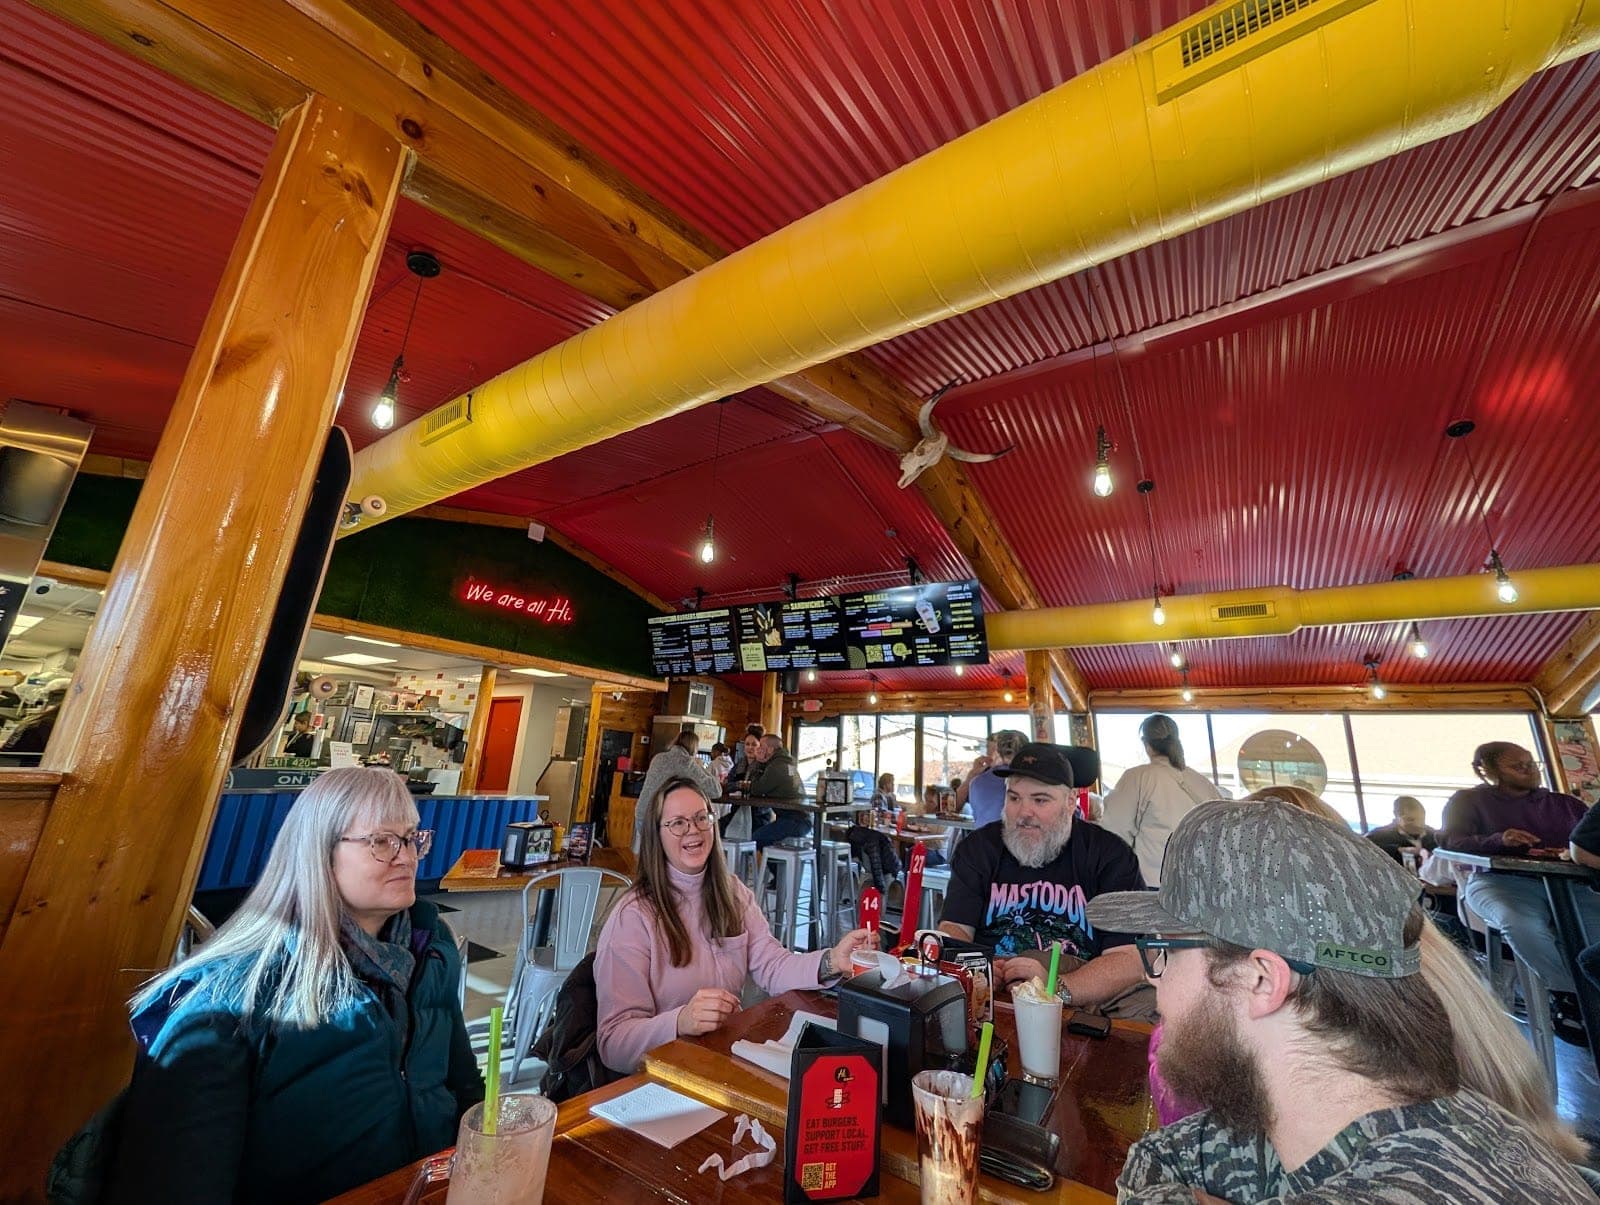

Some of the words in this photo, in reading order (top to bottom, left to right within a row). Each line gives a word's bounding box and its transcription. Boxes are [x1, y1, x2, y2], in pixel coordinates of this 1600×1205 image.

[466, 584, 494, 601] We
[497, 594, 525, 609] are
[527, 600, 547, 615] all
[266, 757, 290, 767] EXIT
[292, 758, 311, 767] 420
[278, 775, 303, 785] ON
[912, 854, 925, 874] 27
[863, 896, 879, 911] 14
[1321, 947, 1388, 966] AFTCO
[805, 1118, 820, 1129] EAT
[822, 1116, 859, 1128] BURGERS.
[805, 1129, 840, 1141] SUPPORT
[842, 1127, 868, 1139] LOCAL.
[804, 1143, 820, 1153] GET
[821, 1141, 839, 1152] FREE
[841, 1140, 867, 1151] STUFF.
[825, 1162, 837, 1171] GET
[825, 1171, 836, 1180] THE
[824, 1180, 836, 1188] APP
